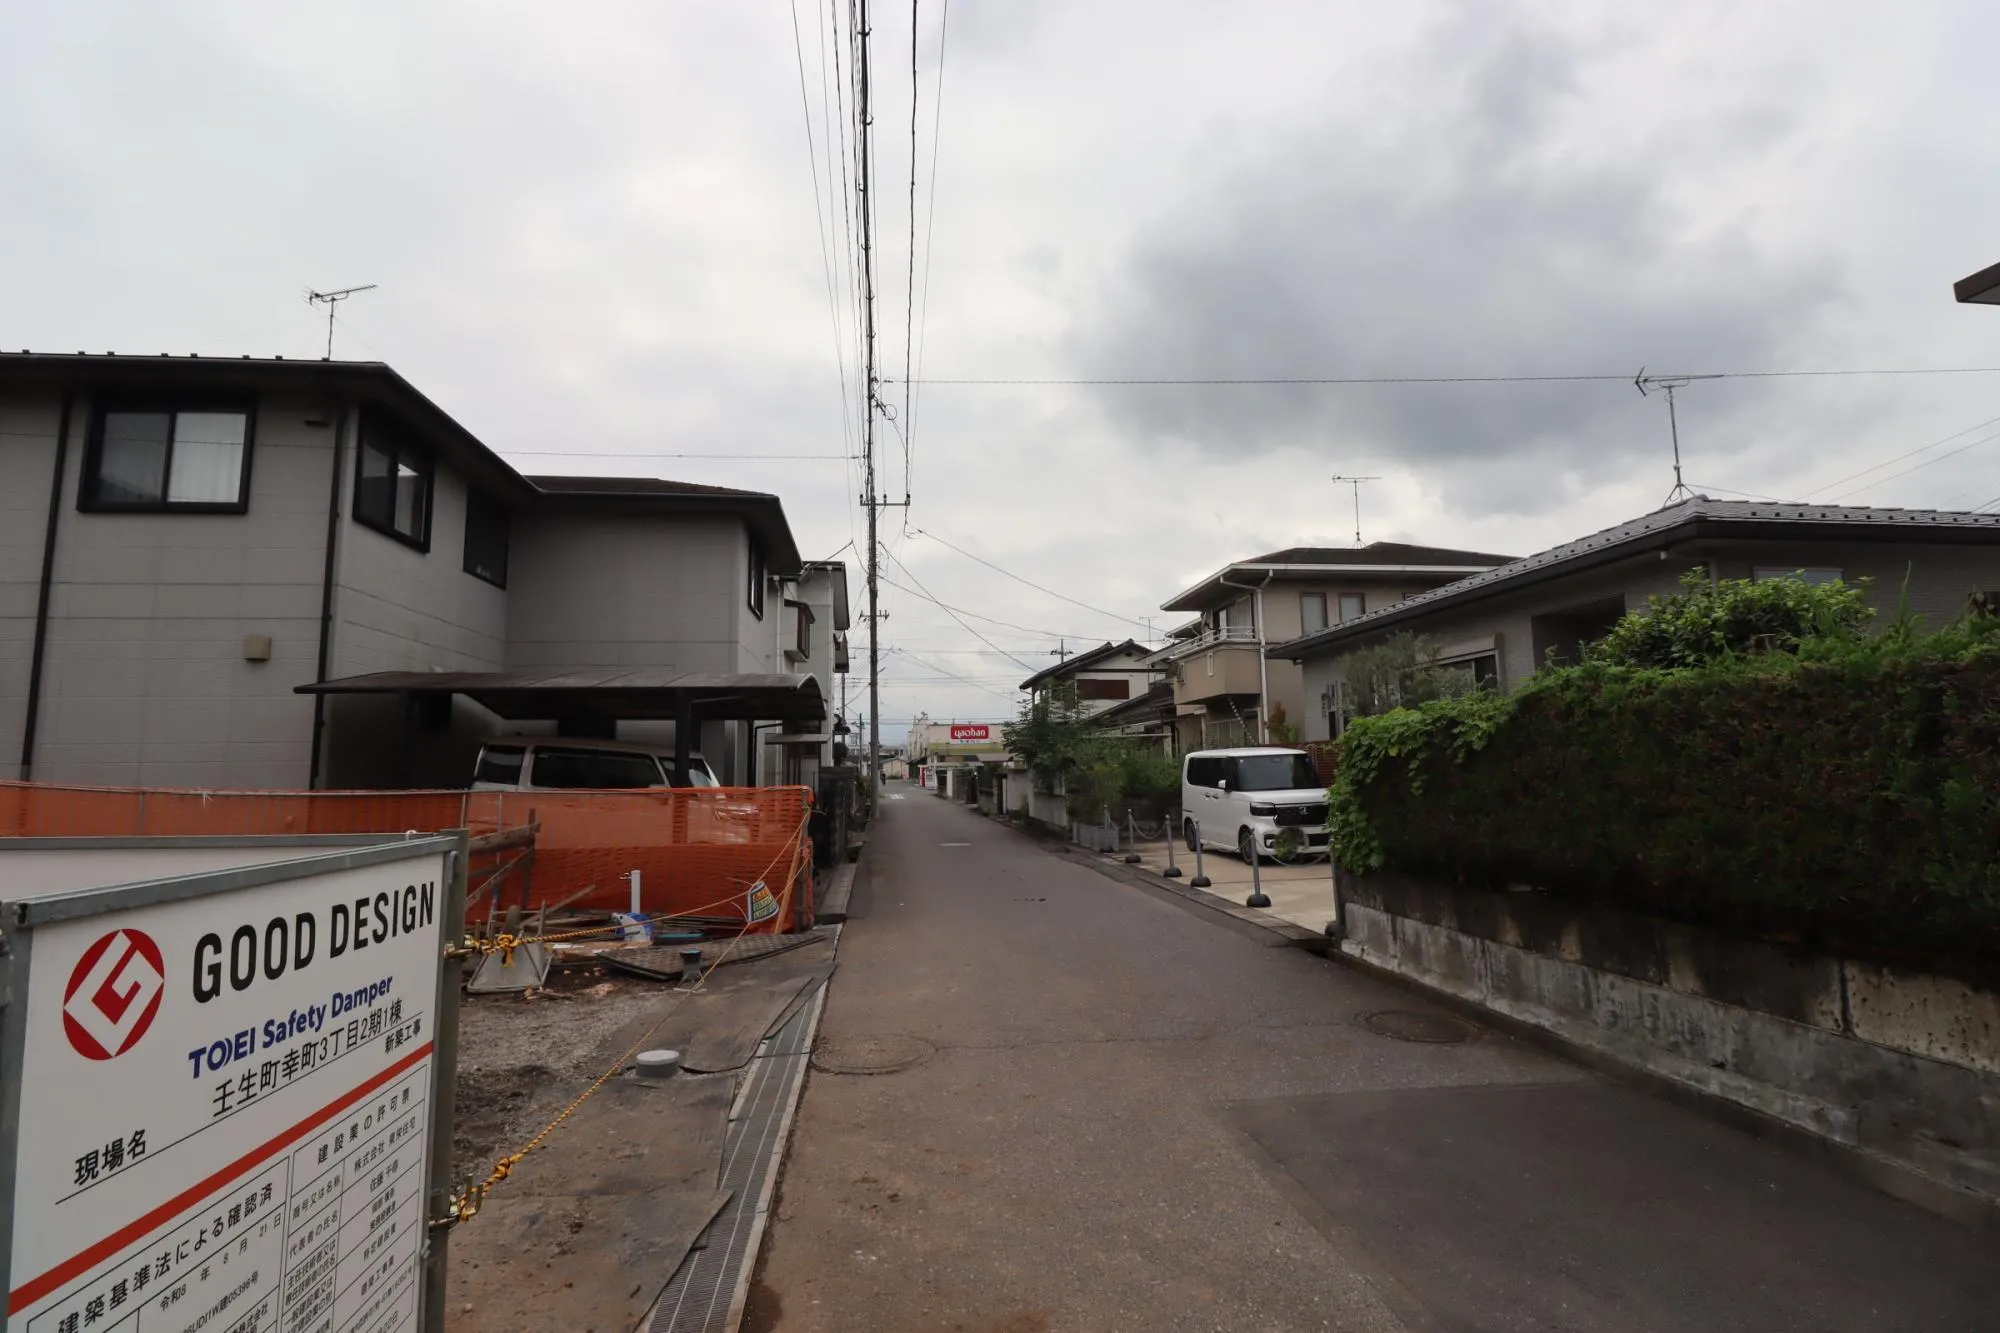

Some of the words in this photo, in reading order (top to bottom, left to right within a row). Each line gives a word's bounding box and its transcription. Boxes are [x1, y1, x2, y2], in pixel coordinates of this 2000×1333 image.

[193, 912, 316, 1004] GOOD
[330, 881, 434, 959] DESIGN
[262, 1004, 327, 1048] Safety
[331, 976, 393, 1018] Damper
[385, 1019, 421, 1054] 新築工事
[212, 998, 403, 1117] 壬生町幸町3丁目2期1棟
[74, 1129, 146, 1186] 現場名
[318, 1087, 410, 1165] 建設業の許可票
[58, 1182, 273, 1333] 建築基準法による確認済
